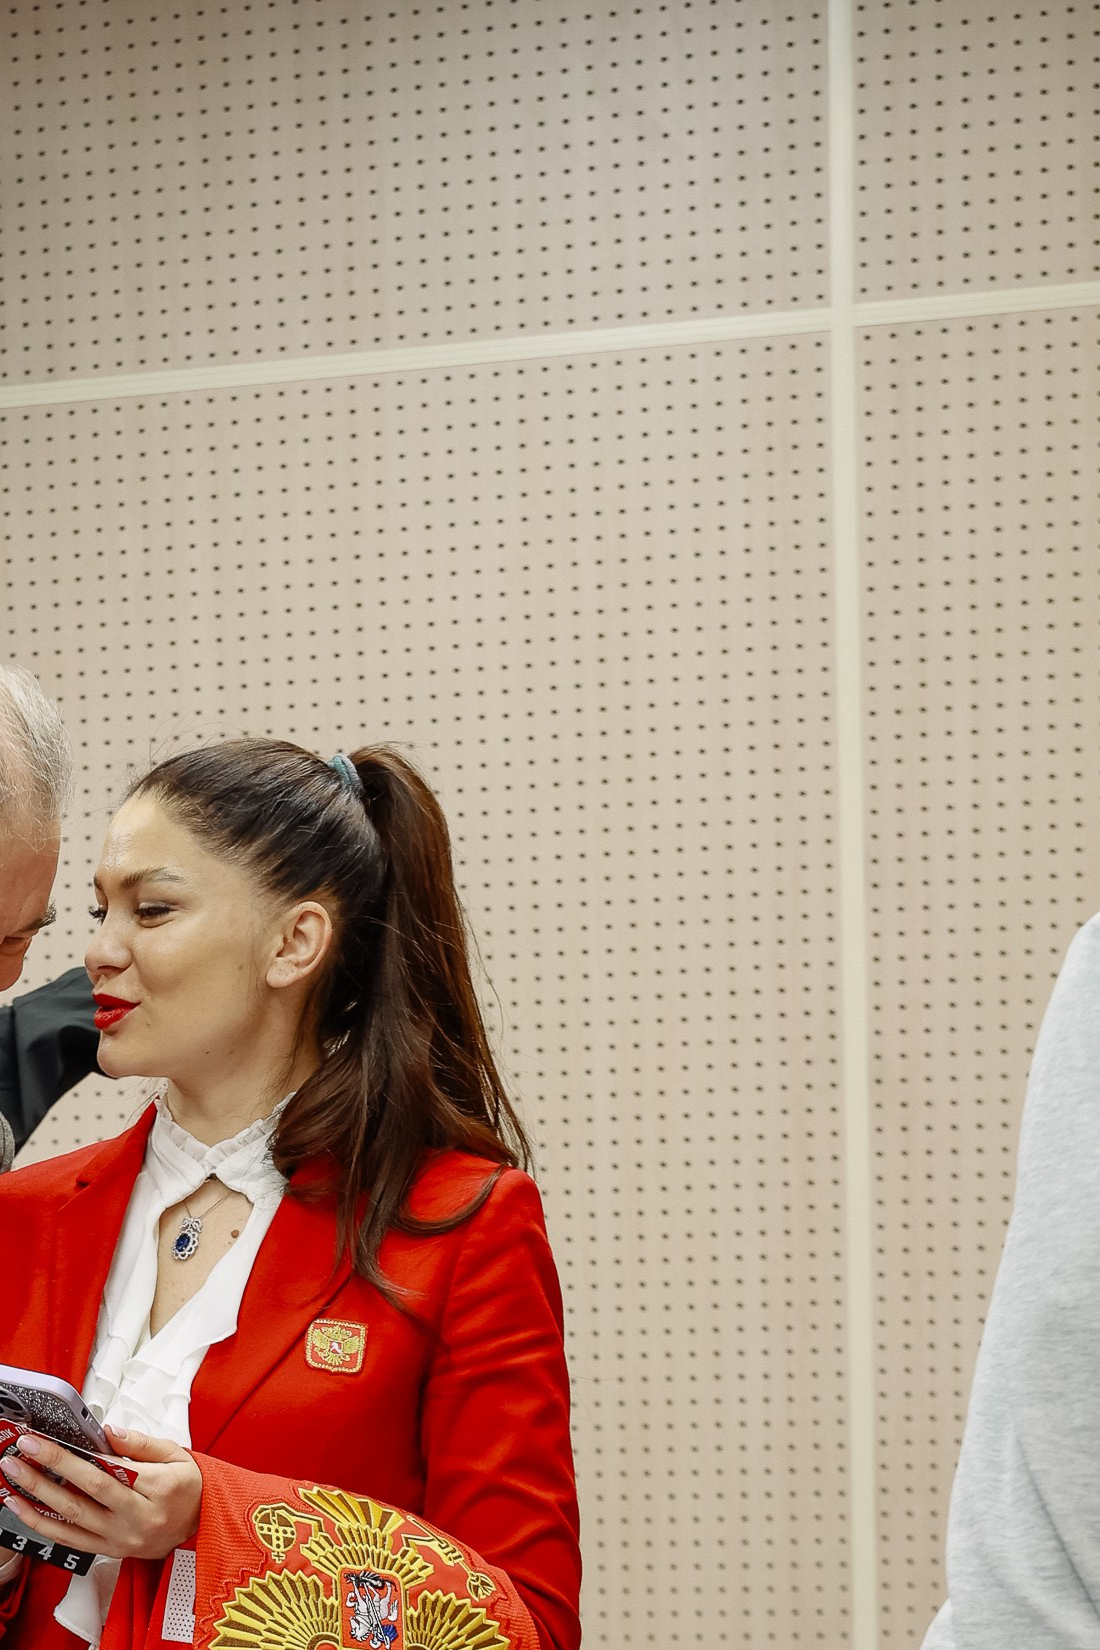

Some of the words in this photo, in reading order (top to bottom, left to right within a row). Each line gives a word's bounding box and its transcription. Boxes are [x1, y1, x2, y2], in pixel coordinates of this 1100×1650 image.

[12, 1535, 28, 1551] 3
[38, 1544, 54, 1561] 4
[63, 1554, 81, 1570] 5
